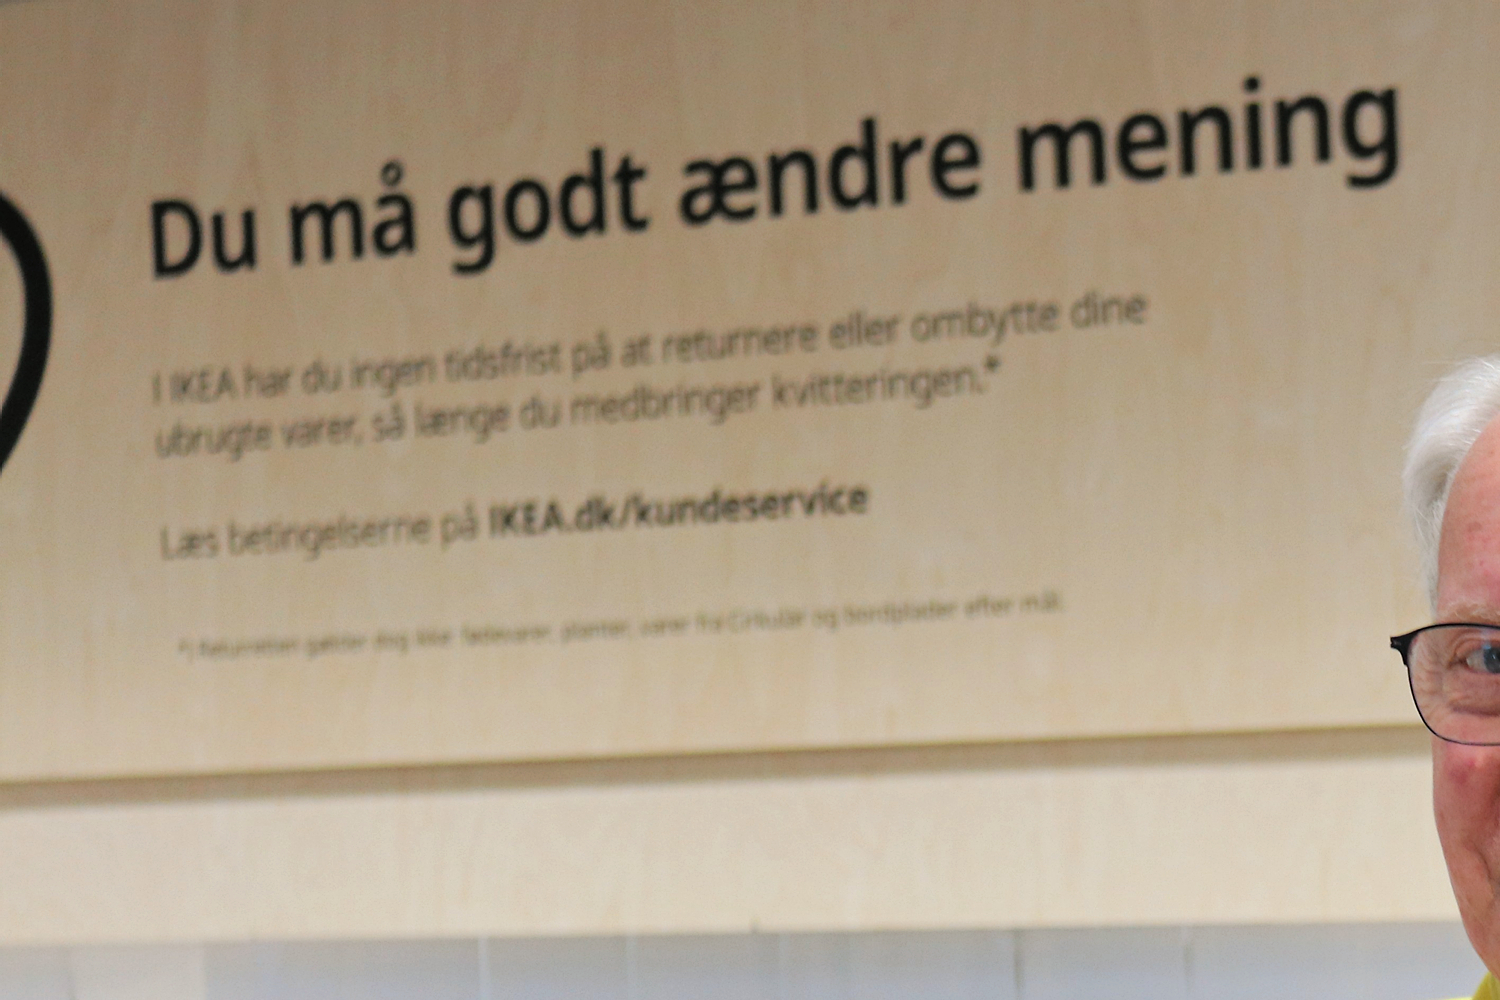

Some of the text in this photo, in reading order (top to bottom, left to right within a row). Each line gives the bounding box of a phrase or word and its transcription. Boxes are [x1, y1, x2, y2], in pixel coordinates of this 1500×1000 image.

[150, 75, 1402, 282] Du må godt ændre mening
[168, 362, 235, 404] IKEA
[242, 360, 293, 400] har
[302, 357, 344, 396] du
[350, 352, 437, 399] ingen
[444, 338, 562, 384] tidsfrist
[570, 330, 613, 381] på
[620, 333, 653, 368] at
[660, 324, 820, 364] returnere
[827, 310, 900, 350] eller
[908, 300, 1061, 346] ombytte
[1068, 289, 1149, 329] dine
[154, 415, 273, 463] ubrugte
[279, 413, 364, 450] varer,
[369, 400, 406, 443] så
[412, 397, 511, 446] længe
[517, 394, 561, 431] du
[568, 378, 761, 427] medbringer
[159, 480, 871, 563] Læs betingelserne på IKEA.dk/kundeservice
